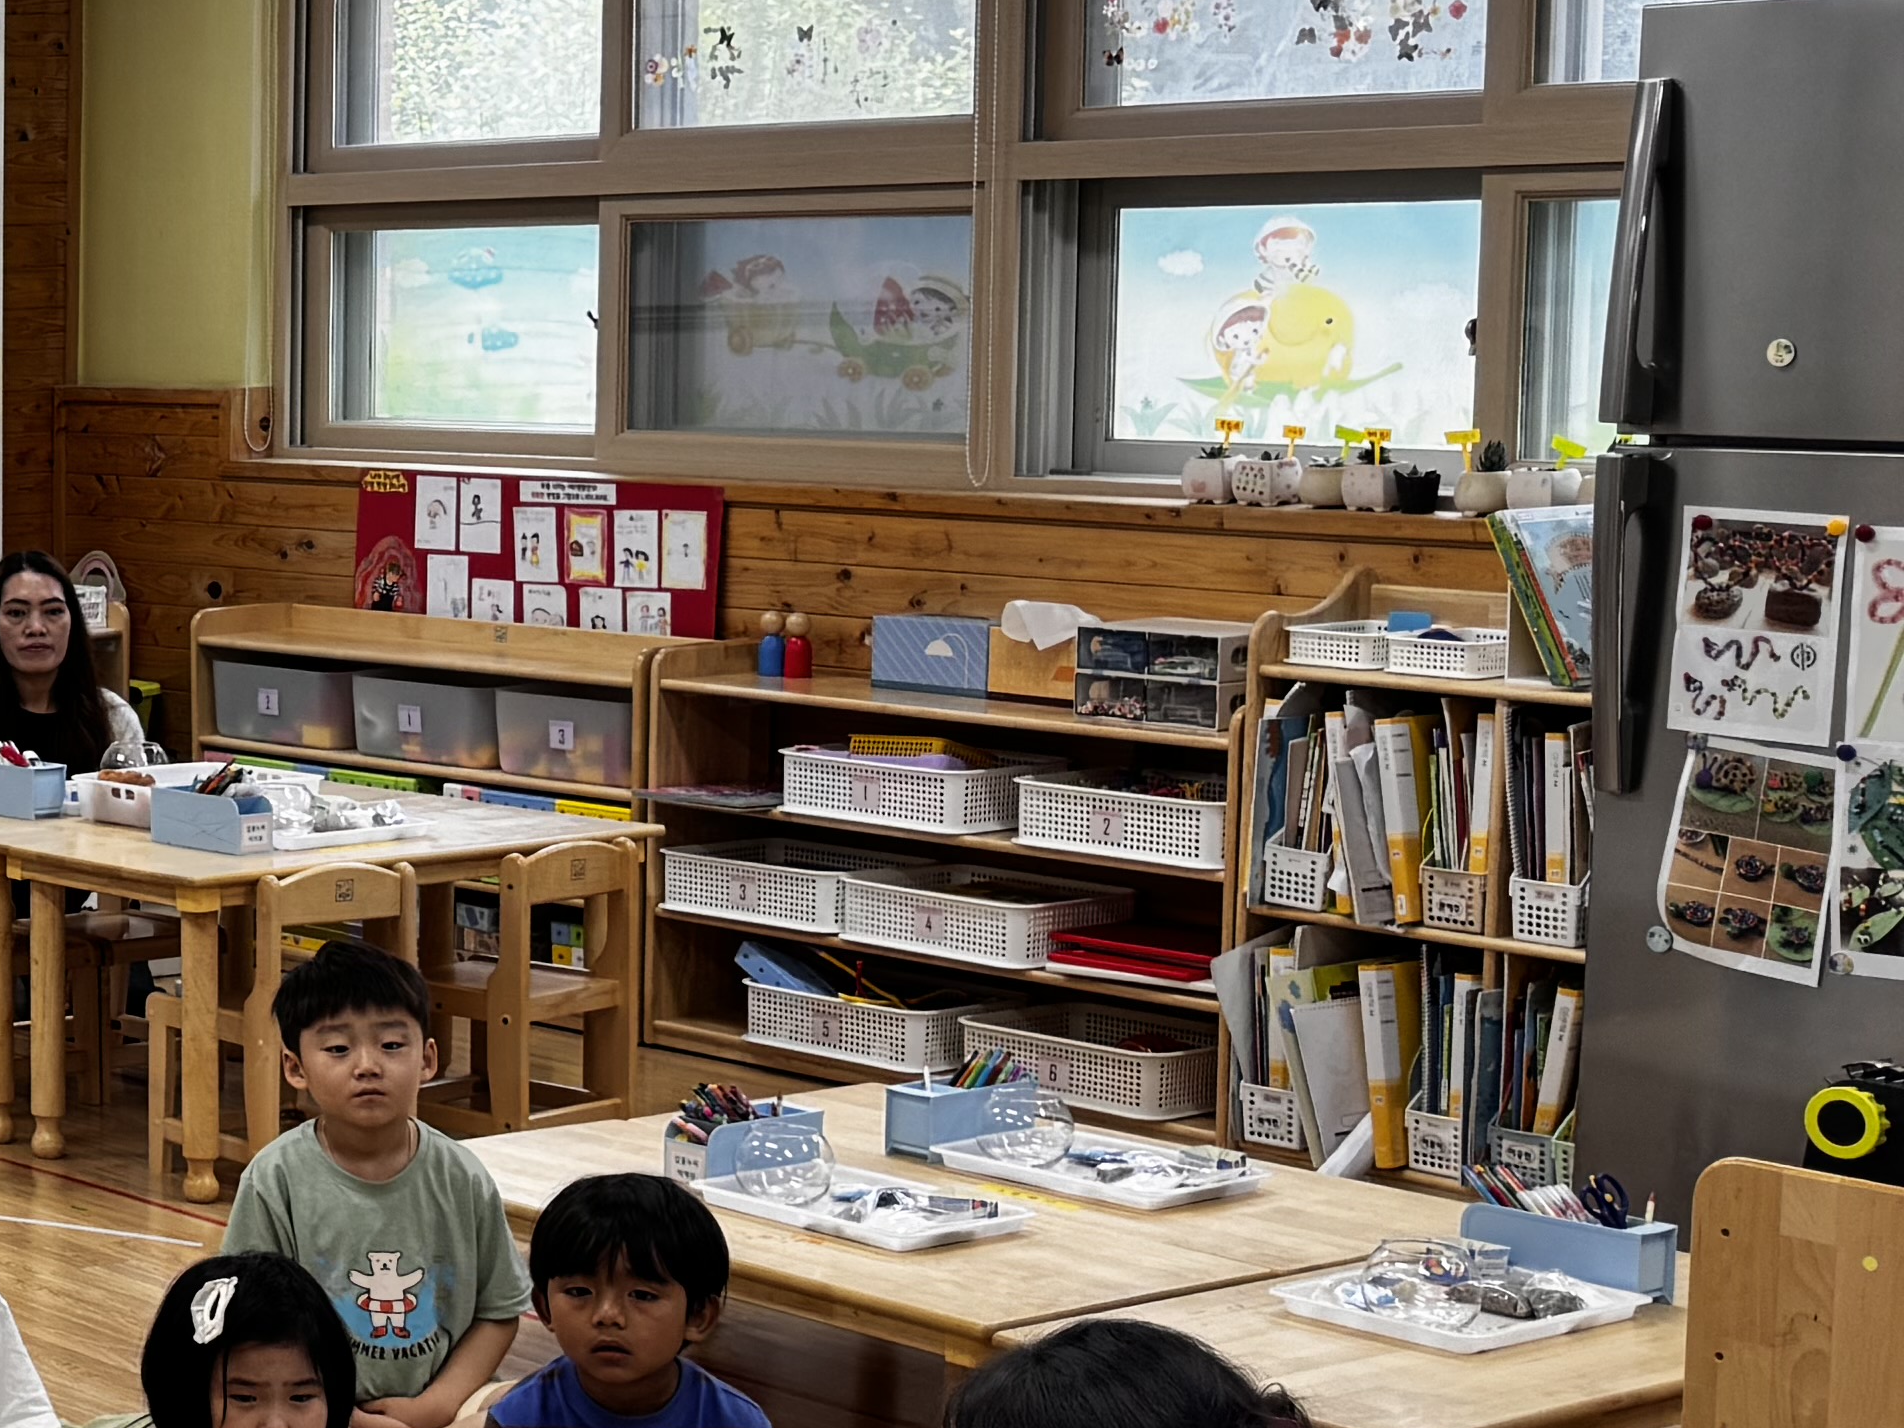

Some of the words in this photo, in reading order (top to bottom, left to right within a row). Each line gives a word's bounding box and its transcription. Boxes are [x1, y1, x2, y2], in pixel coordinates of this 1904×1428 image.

[558, 728, 565, 745] 3
[1103, 817, 1111, 836] 2
[739, 884, 747, 901] 3
[925, 915, 932, 932] 4
[822, 1020, 830, 1038] 5
[1049, 1063, 1057, 1082] 6
[391, 1331, 442, 1360] VACATI
